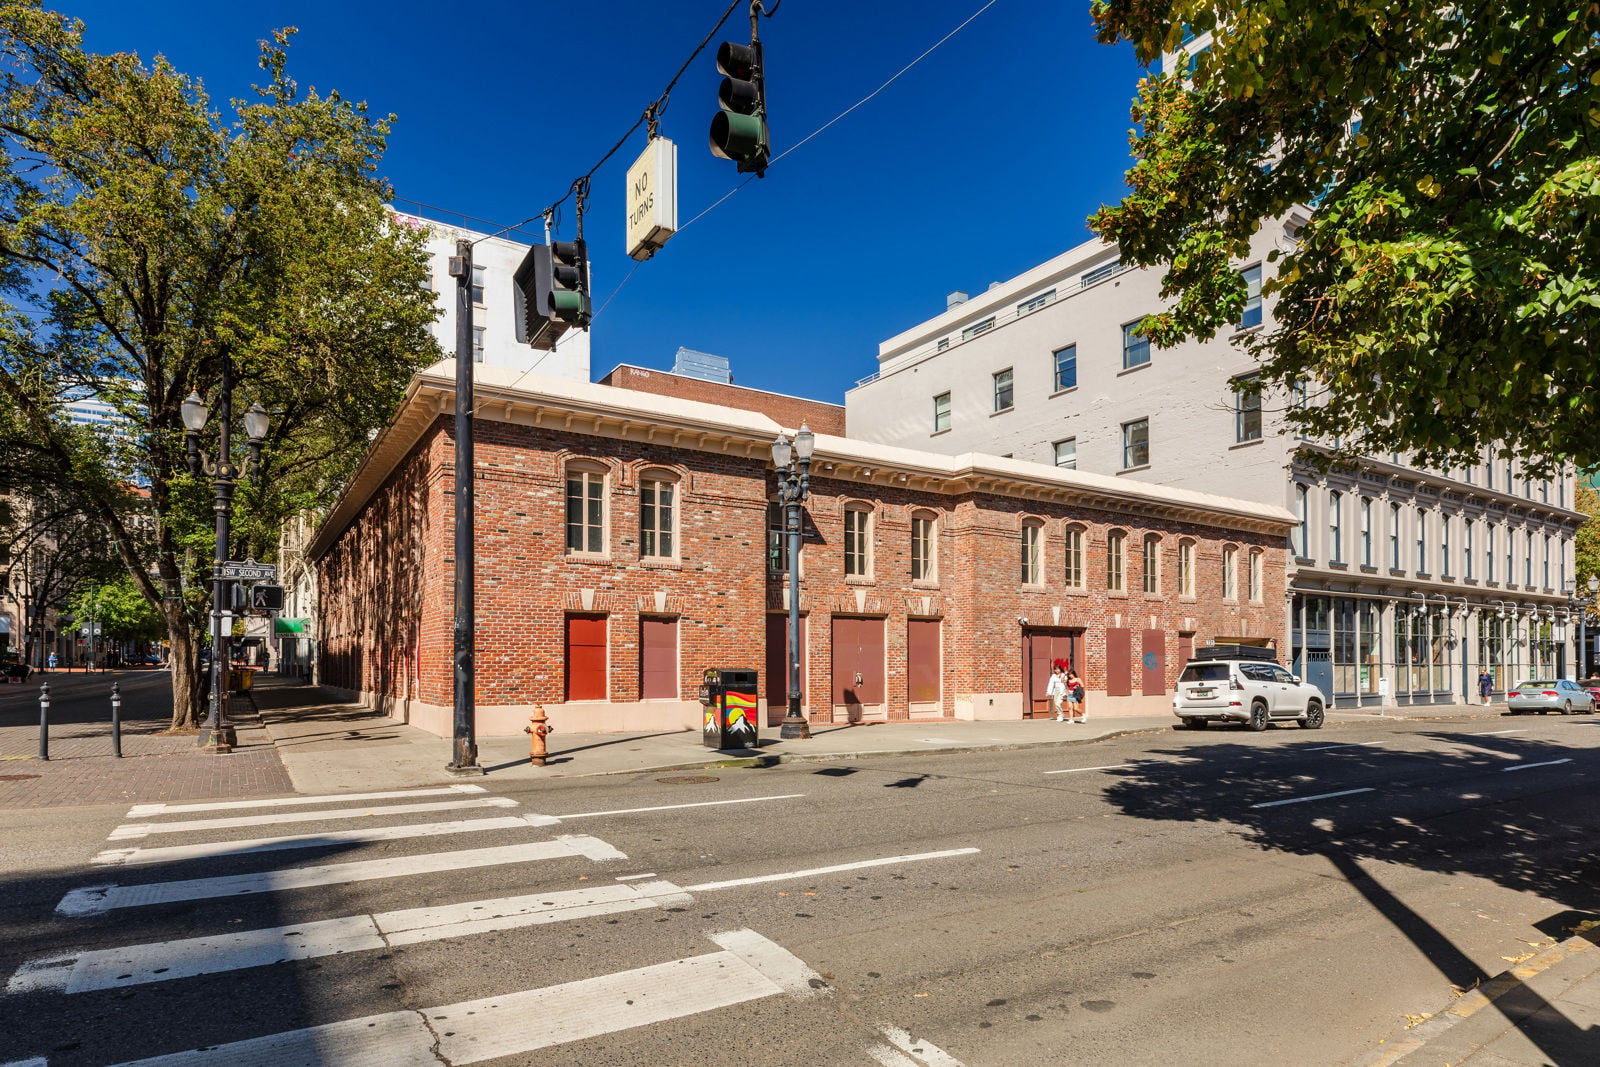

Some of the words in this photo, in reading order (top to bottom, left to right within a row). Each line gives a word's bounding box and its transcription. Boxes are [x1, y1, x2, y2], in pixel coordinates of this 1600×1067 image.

[635, 172, 648, 200] NO
[629, 192, 654, 229] TURNS
[226, 568, 236, 576] SW
[239, 569, 262, 577] SECOND
[264, 570, 274, 578] AVE
